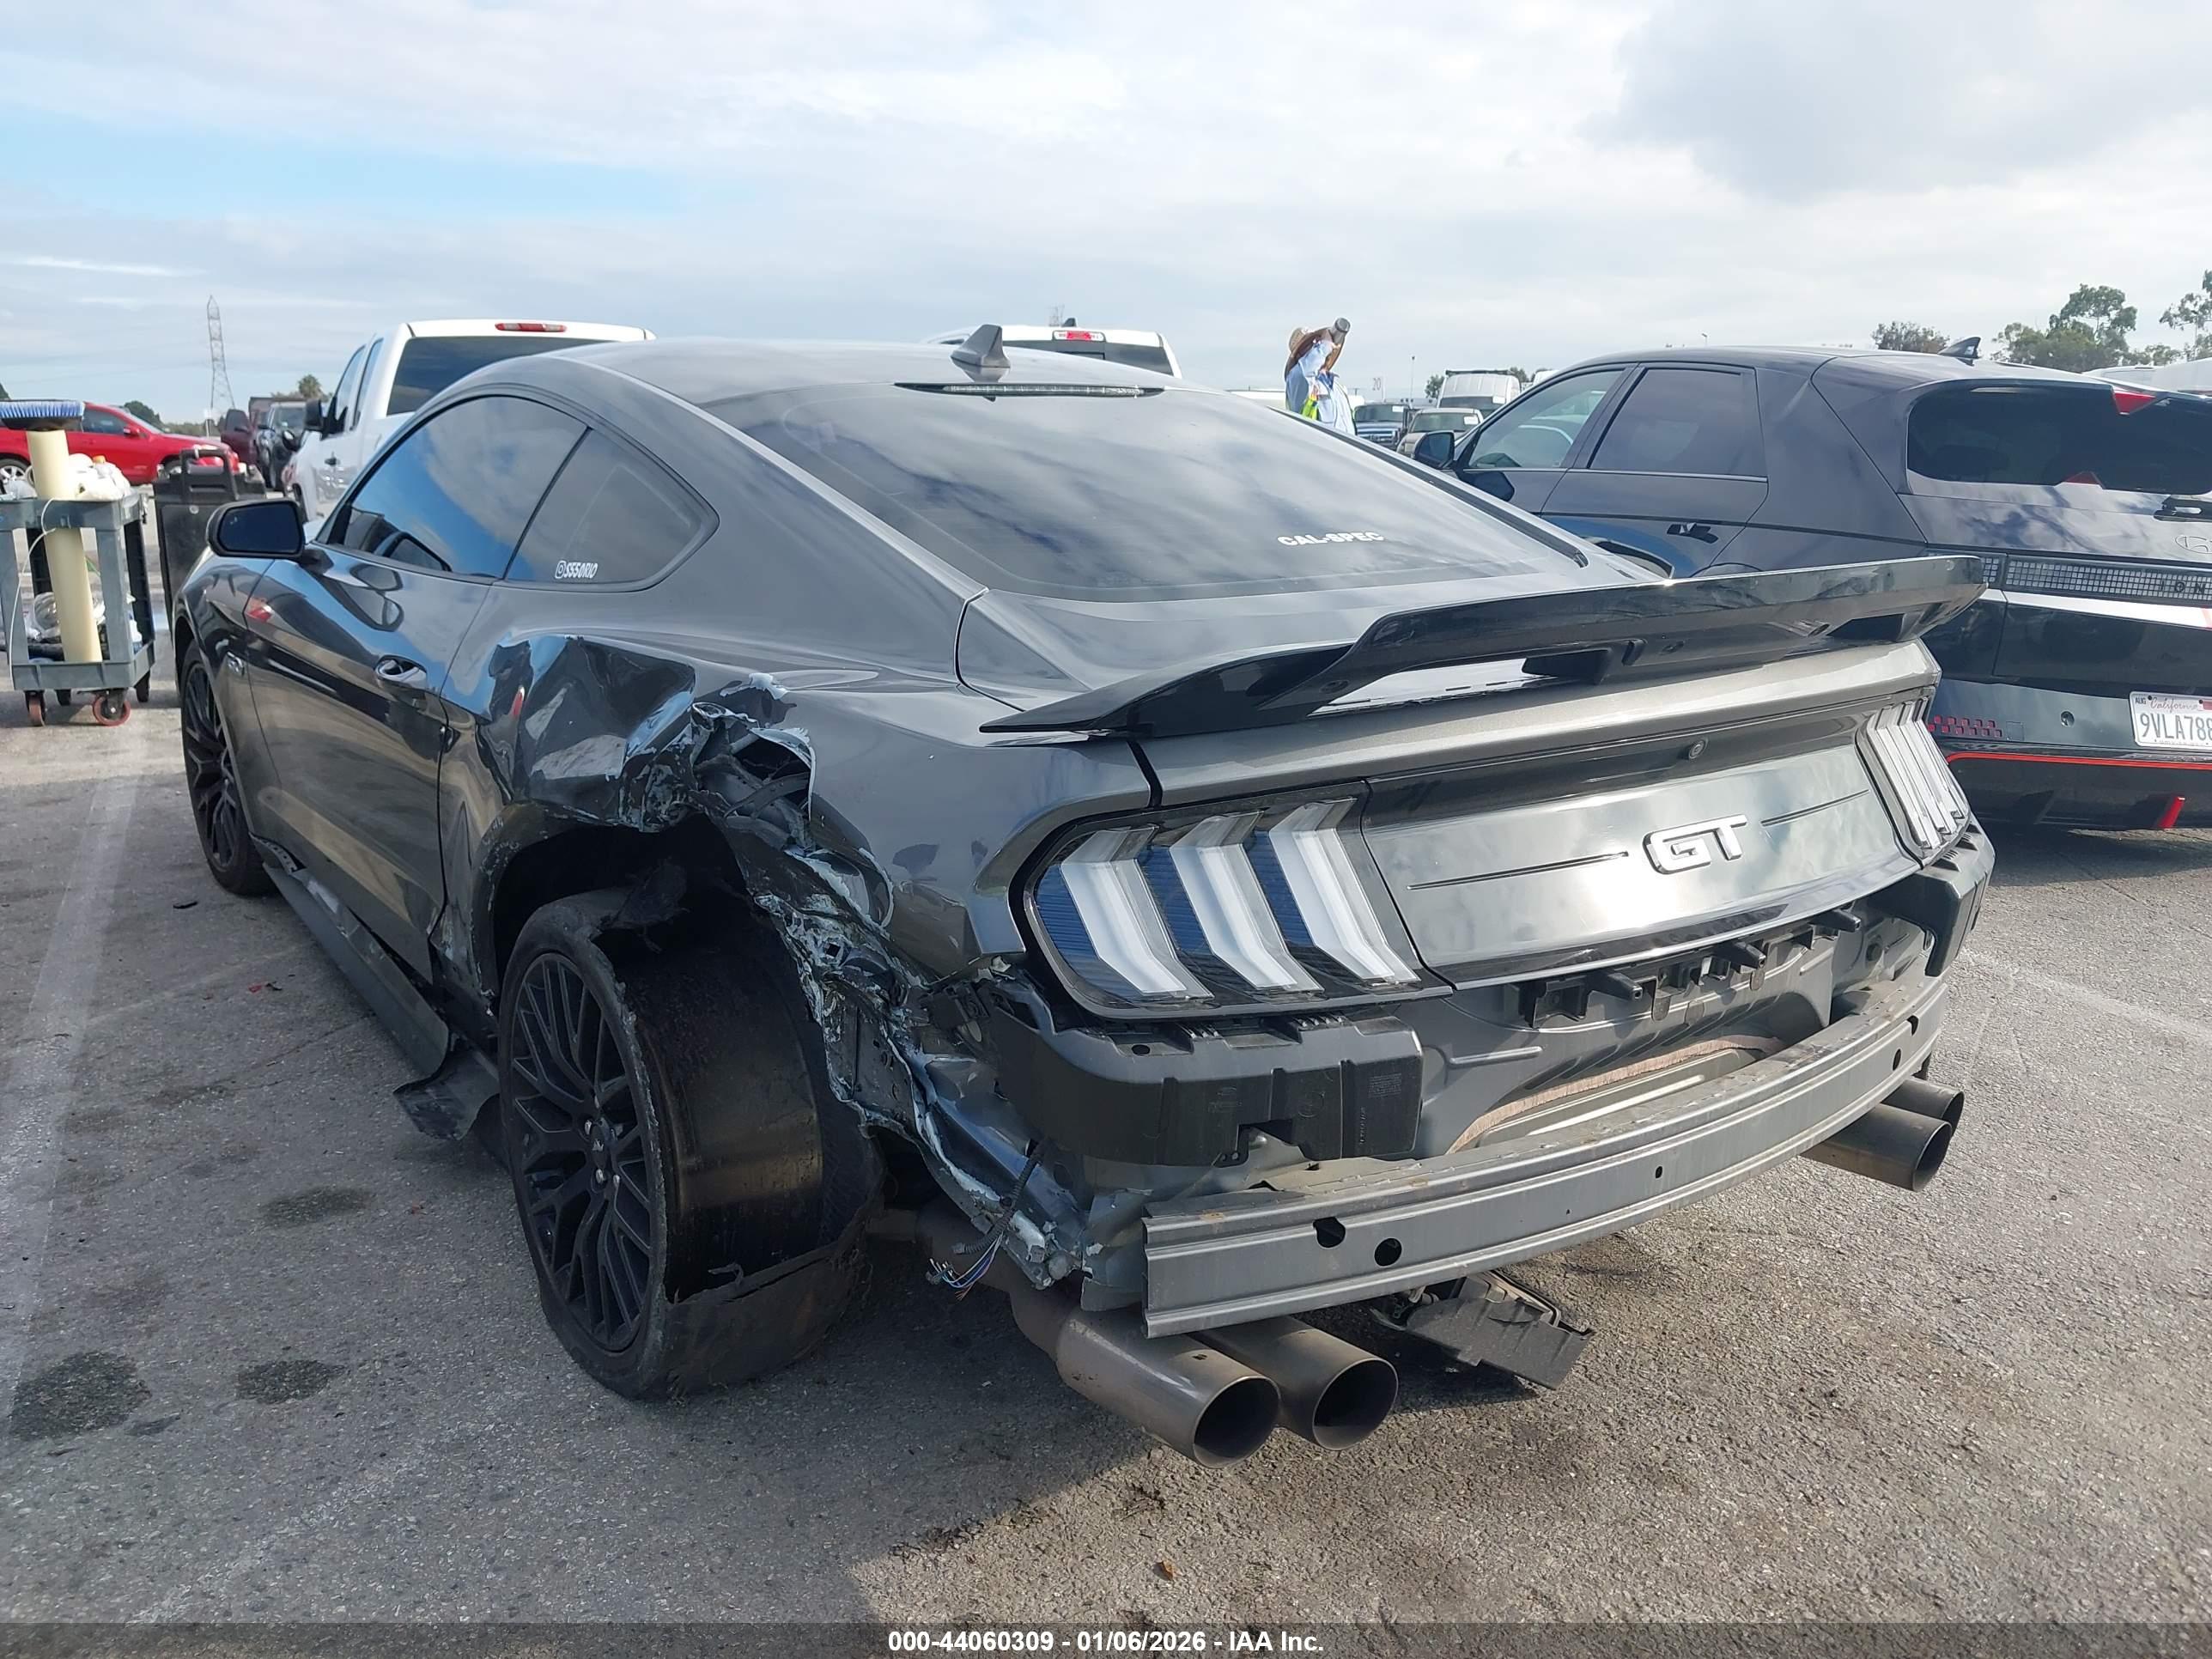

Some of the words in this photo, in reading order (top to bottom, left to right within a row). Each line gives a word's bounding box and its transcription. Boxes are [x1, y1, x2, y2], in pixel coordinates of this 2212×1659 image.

[1277, 532, 1384, 546] CAL-SPEC
[2150, 696, 2198, 714] California
[1643, 814, 1747, 875] GT
